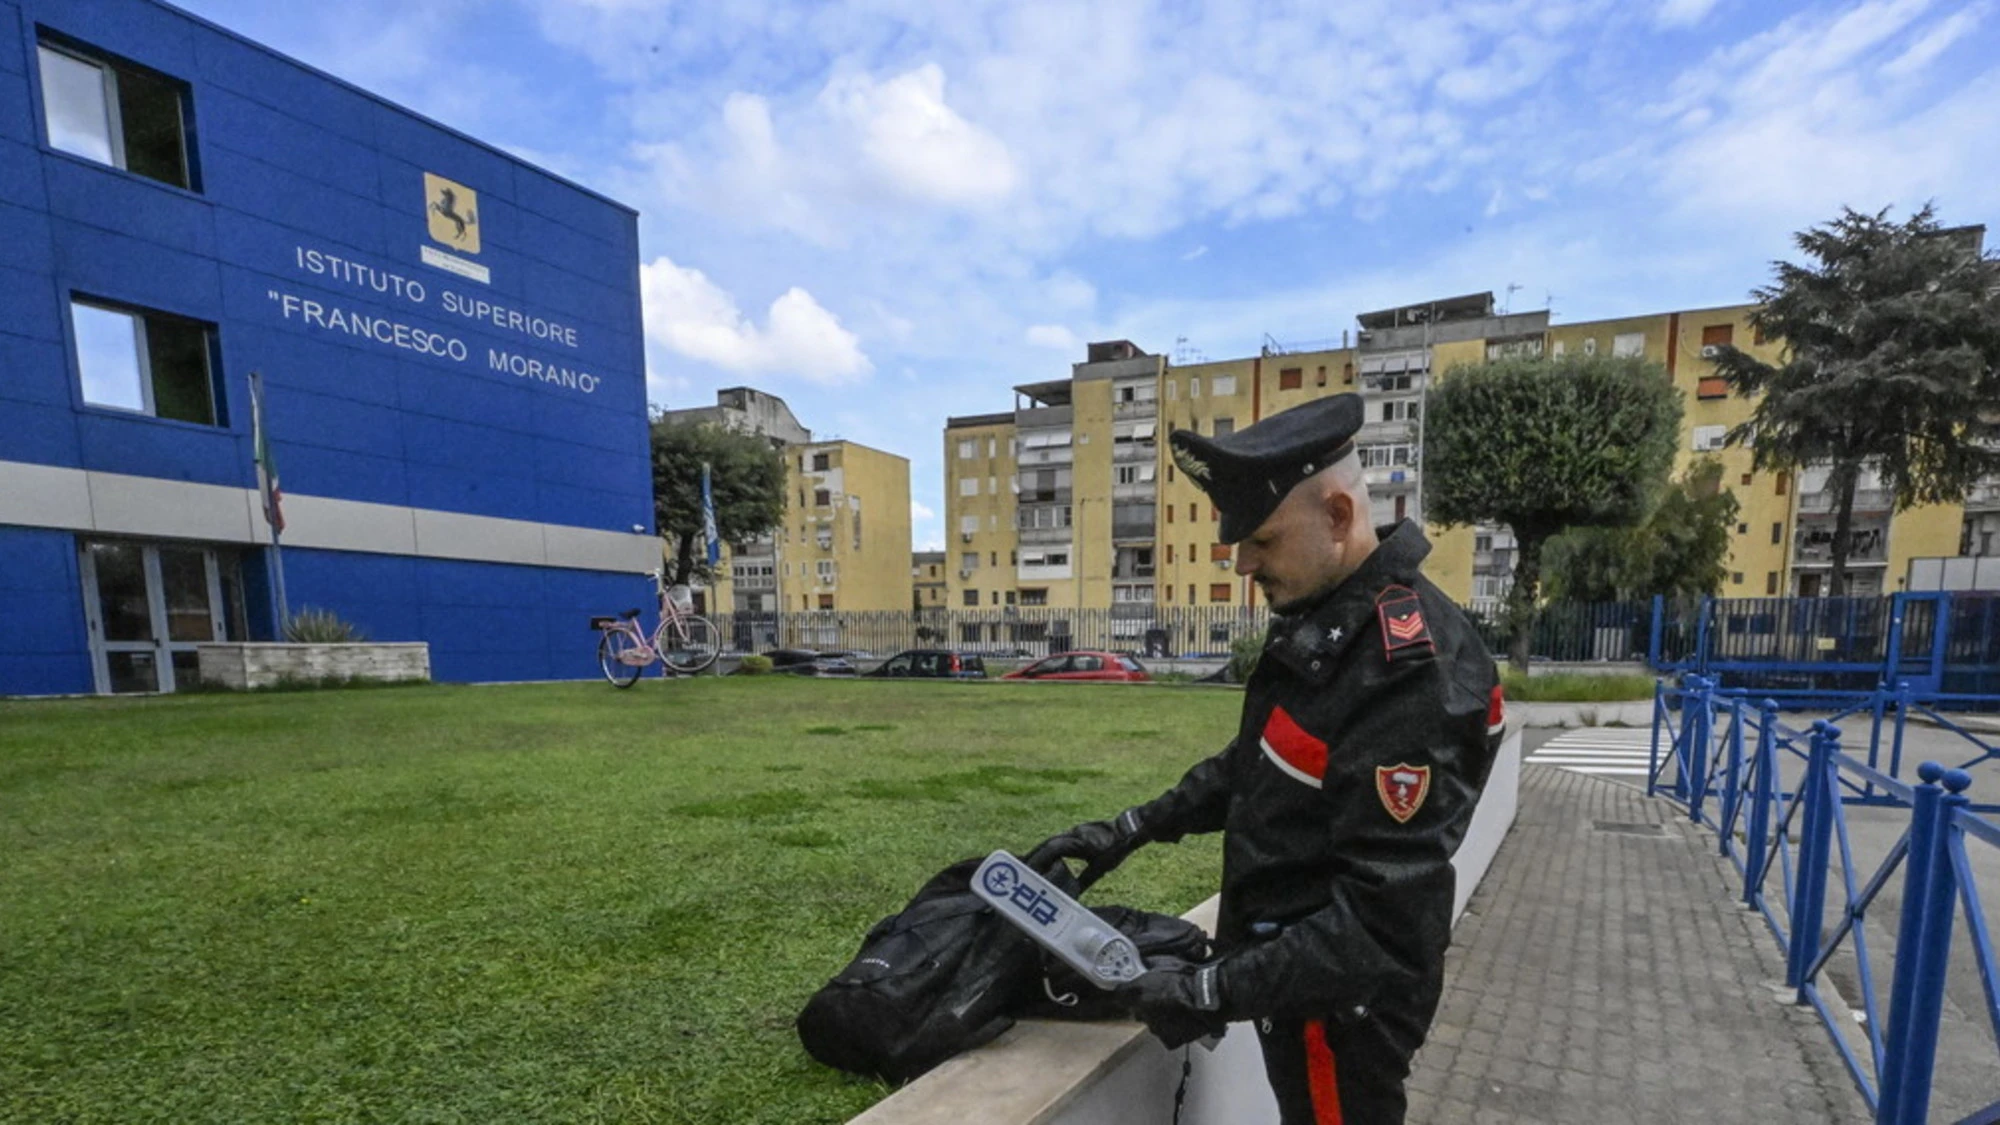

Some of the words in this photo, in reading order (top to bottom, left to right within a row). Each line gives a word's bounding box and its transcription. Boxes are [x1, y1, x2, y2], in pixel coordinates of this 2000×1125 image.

[268, 290, 467, 361] "FRANCESCO
[488, 348, 600, 393] MORANO"
[296, 246, 426, 302] ISTITUTO
[442, 291, 578, 348] SUPERIORE
